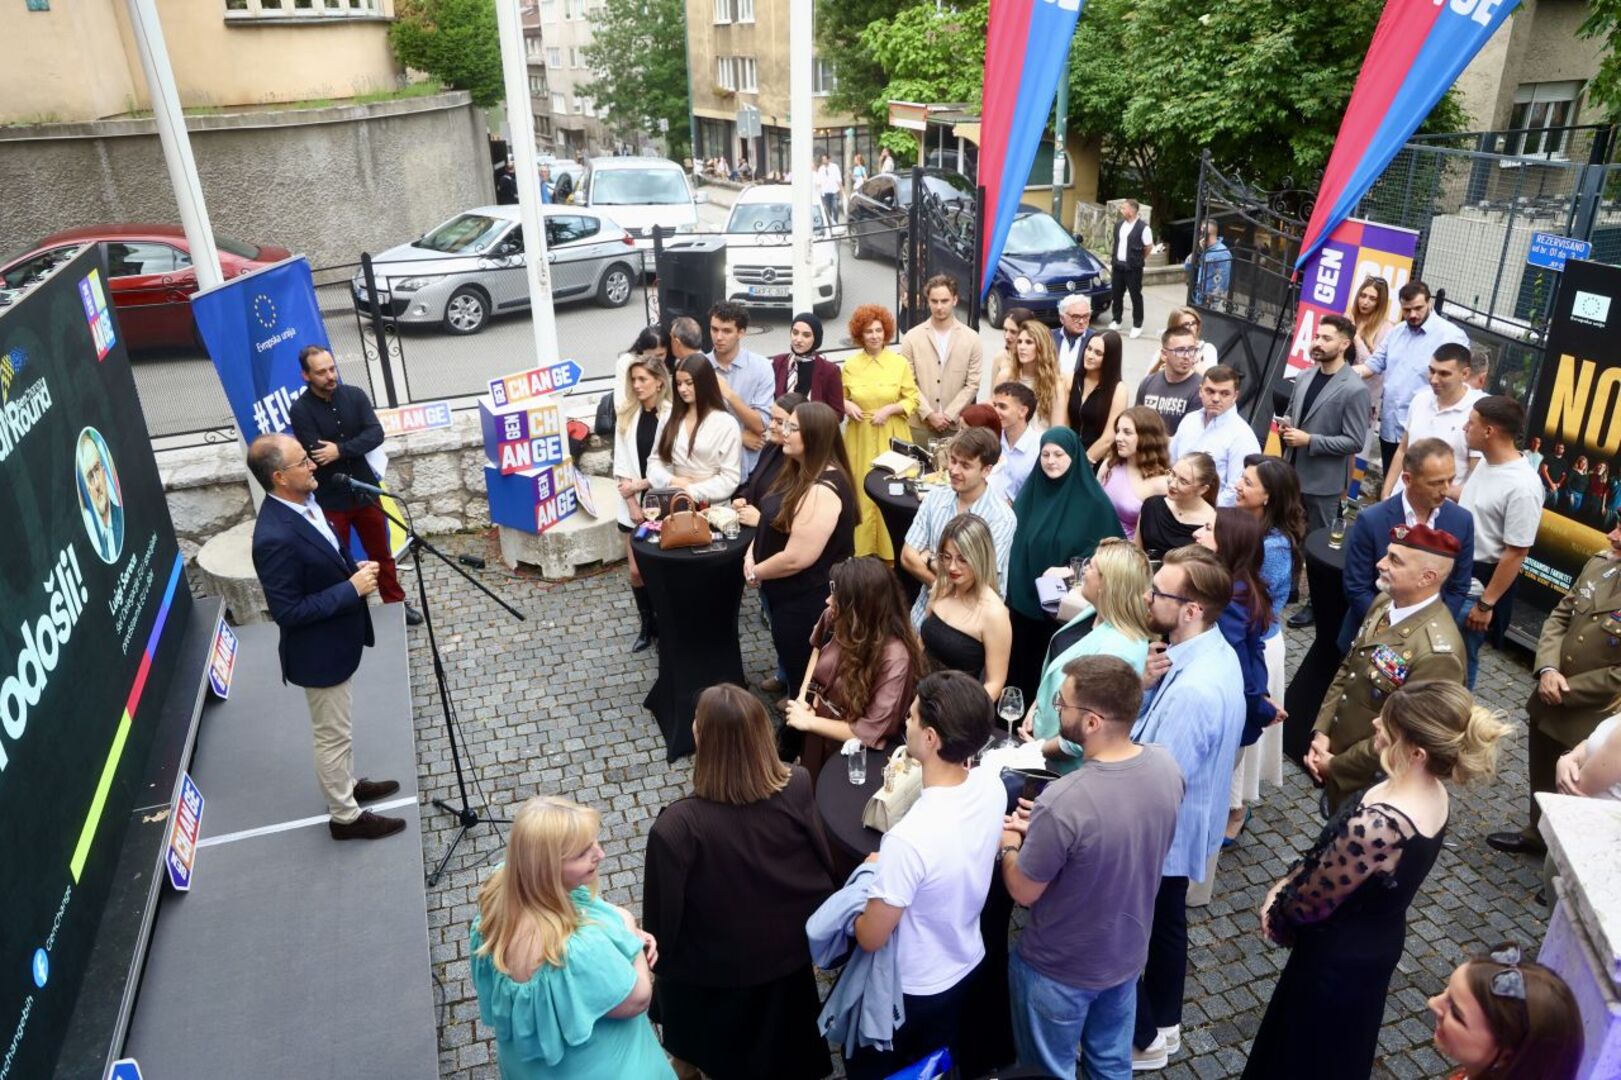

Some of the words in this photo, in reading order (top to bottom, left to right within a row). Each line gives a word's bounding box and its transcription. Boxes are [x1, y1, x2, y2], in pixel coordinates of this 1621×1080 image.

[1536, 234, 1585, 253] REZERVISANO
[1314, 248, 1344, 304] GEN
[508, 365, 573, 400] CHANGE
[504, 414, 521, 440] GEN
[529, 409, 559, 436] CH
[537, 473, 550, 501] GEN
[554, 461, 575, 489] CH
[0, 542, 88, 772] odošli!
